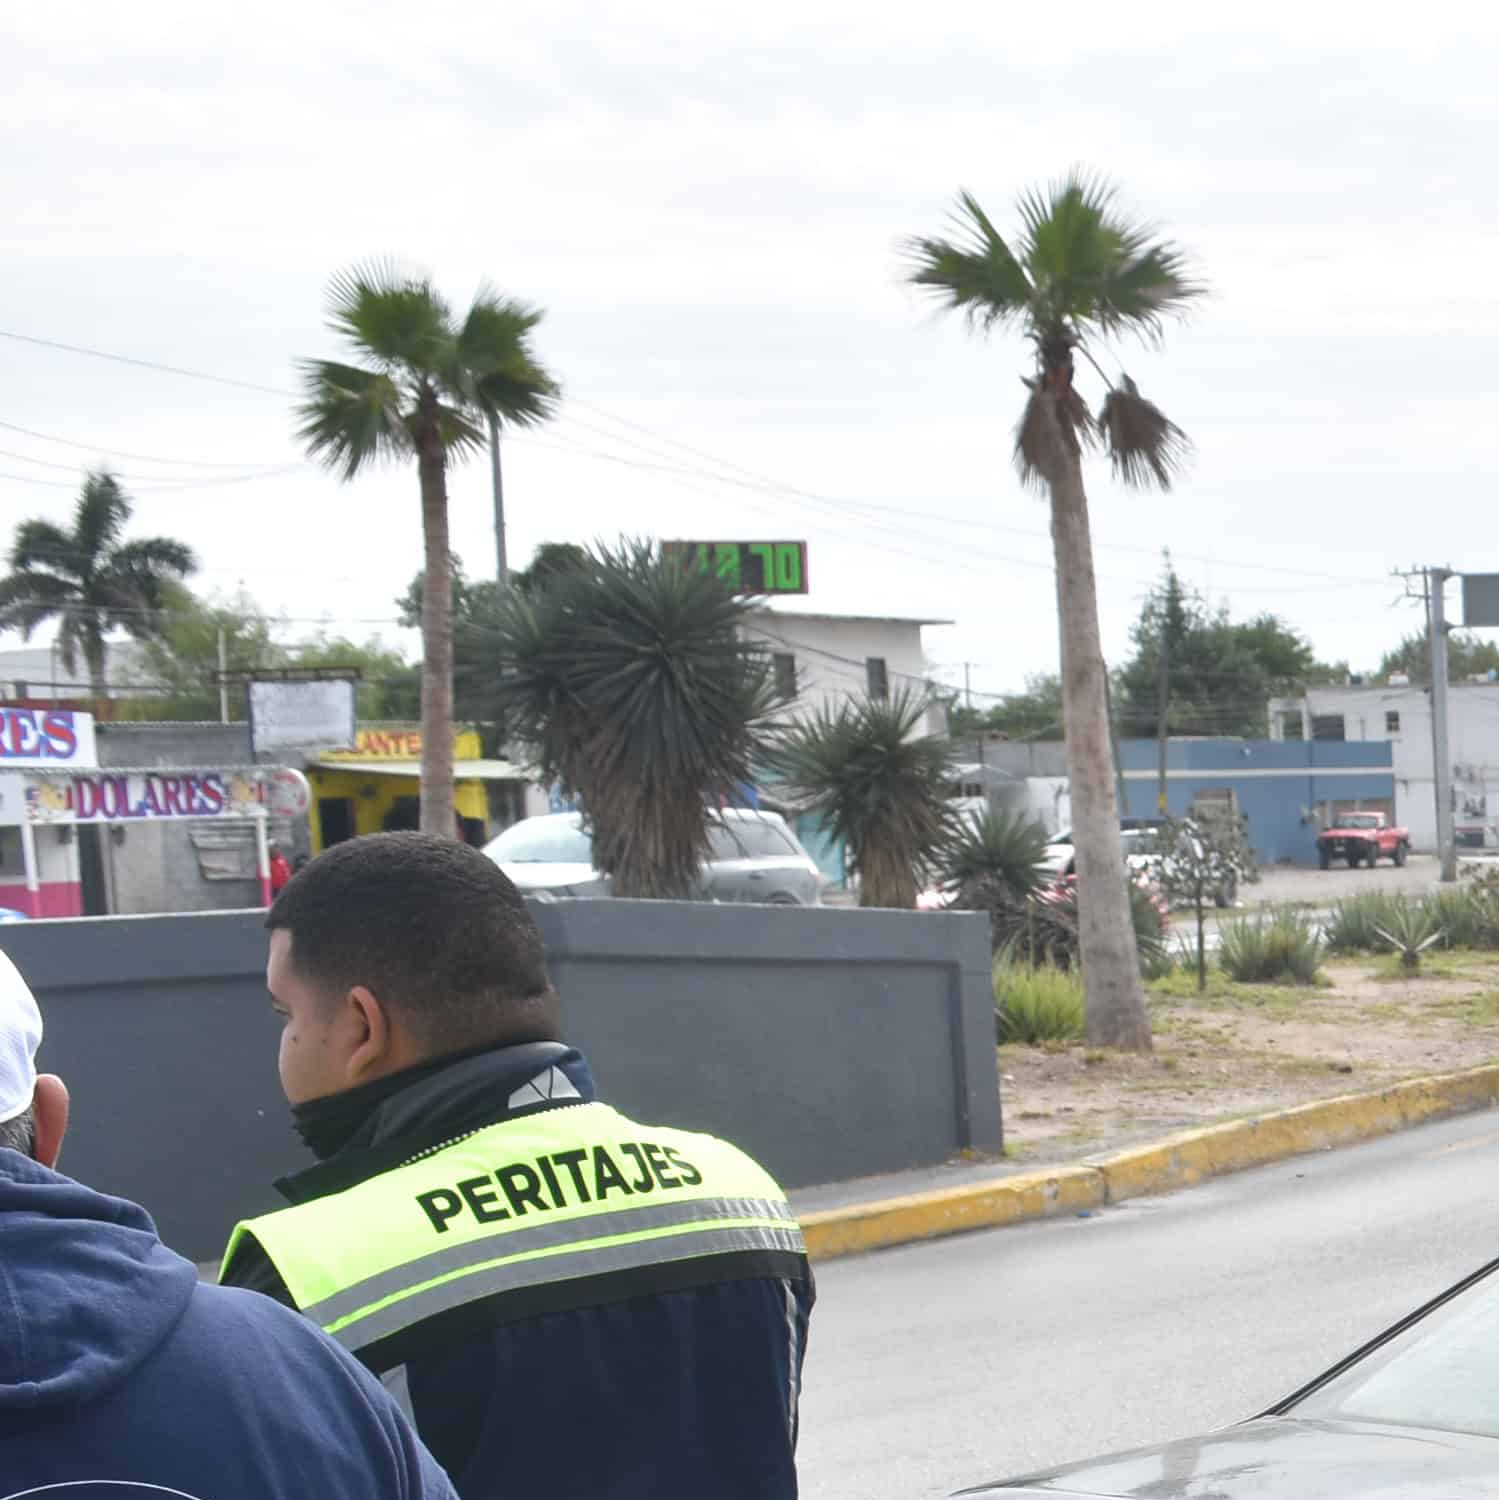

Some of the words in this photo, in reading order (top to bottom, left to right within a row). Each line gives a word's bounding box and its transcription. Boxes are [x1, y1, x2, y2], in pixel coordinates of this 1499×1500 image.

[0, 710, 78, 759] ES
[71, 773, 224, 818] DOLARES
[416, 1143, 702, 1234] PERITAJES
